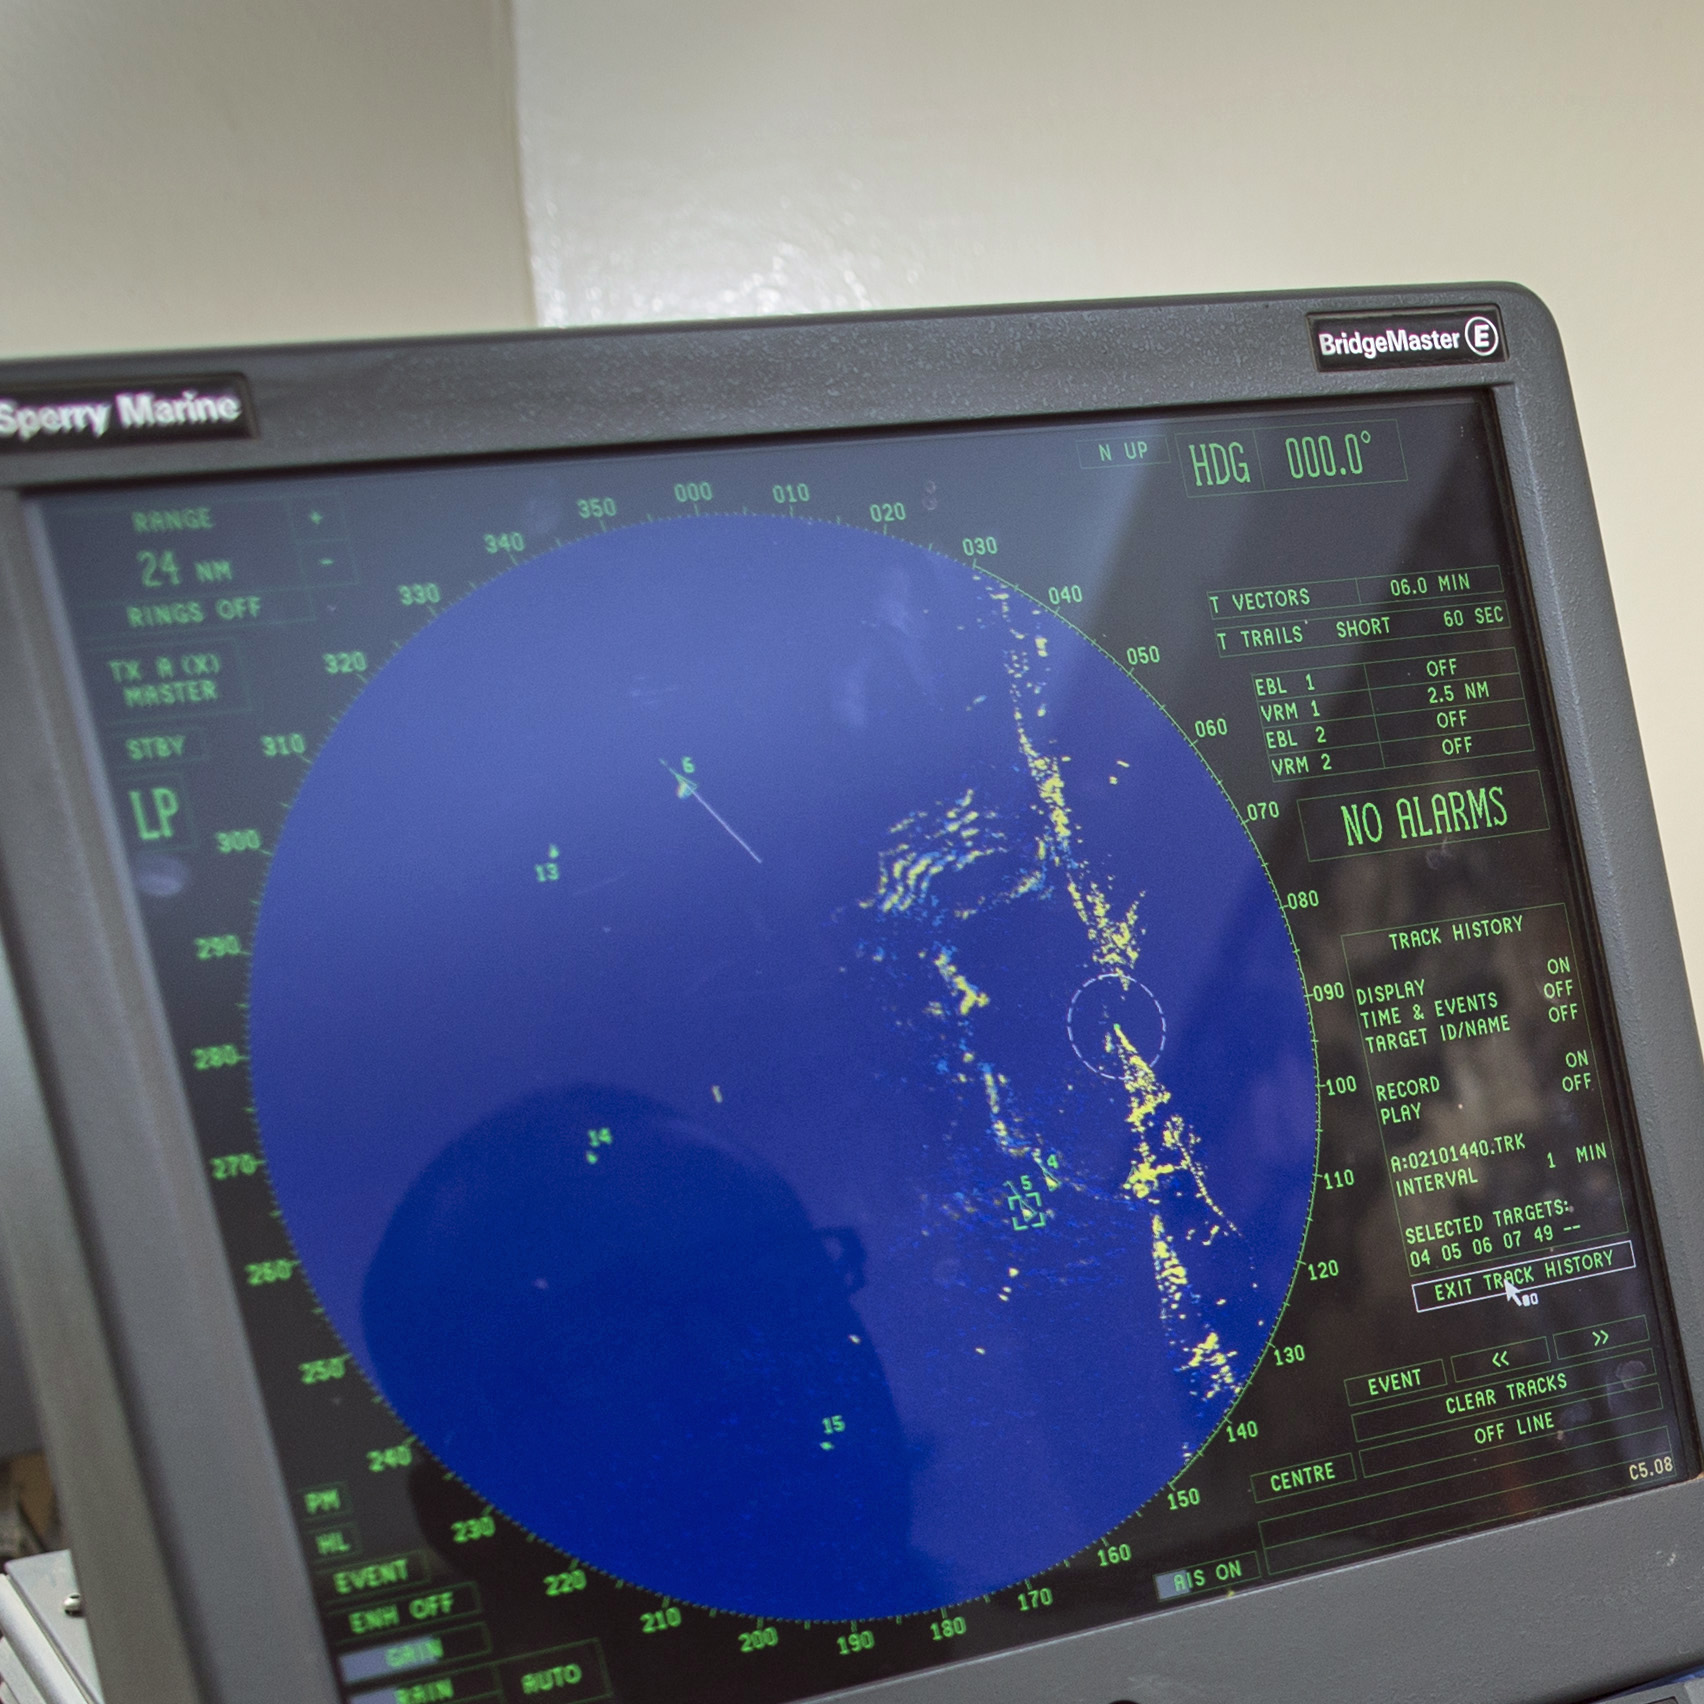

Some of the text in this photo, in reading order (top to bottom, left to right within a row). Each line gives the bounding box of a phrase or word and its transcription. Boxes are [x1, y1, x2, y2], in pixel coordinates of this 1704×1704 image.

[1318, 329, 1460, 360] BridgeMaster
[0, 389, 242, 441] Sperry Marine
[1099, 441, 1148, 461] N UP
[1188, 430, 1372, 486] HDG 000.0°
[674, 481, 712, 502] 000
[772, 483, 809, 502] 010
[132, 508, 213, 532] RANGE
[577, 497, 617, 518] 350
[869, 502, 906, 522] 020
[484, 532, 524, 553] 340
[962, 536, 997, 556] 030
[137, 551, 232, 586] 24 NM
[398, 583, 440, 604] 330
[1048, 585, 1082, 605] 040
[1209, 573, 1471, 614] T VECTORS 06.0 MIN
[128, 597, 261, 627] RINGS OFF
[1217, 605, 1504, 651] T TRAILS SHORT 60 SEC
[323, 651, 366, 674] 320
[1126, 646, 1160, 666] 050
[1255, 658, 1457, 697] EBL 1 OFF
[123, 681, 217, 707] MASTER
[1261, 682, 1489, 722] VRM 1 2.5 NM
[1194, 718, 1228, 738] 060
[1265, 710, 1468, 749] EBL 2 OFF
[126, 735, 185, 760] STBY
[261, 733, 305, 757] 310
[1271, 737, 1473, 777] VRM 2 OFF
[129, 788, 179, 839] LP
[1247, 802, 1280, 821] 070
[1340, 786, 1509, 847] NO ALARMS
[1287, 890, 1320, 910] 080
[1389, 915, 1524, 951] TRACK HISTORY
[1313, 981, 1345, 1002] 090
[1356, 957, 1570, 1006] DISPLAY ON
[1360, 979, 1574, 1030] TIME & EVENTS OFF
[1365, 1003, 1579, 1054] TARGET ID/NAME OFF
[1325, 1076, 1357, 1096] 100
[1375, 1050, 1589, 1103] RECORD ON
[1381, 1072, 1592, 1126] PLAY OFF
[1390, 1133, 1526, 1173] A:02101440.TRK
[1323, 1170, 1355, 1190] 110
[1396, 1143, 1607, 1197] INTERVAL 1 MIN
[1405, 1198, 1570, 1244] SELECTED TARGETS:
[1410, 1224, 1555, 1268] 04 05 06 07 49
[1307, 1260, 1339, 1281] 120
[1435, 1249, 1614, 1301] EXIT TRACK HISTORY
[1273, 1344, 1305, 1366] 130
[1367, 1369, 1423, 1396] EVENT
[1445, 1373, 1568, 1414] CLEAR TRACKS
[1226, 1421, 1258, 1442] 140
[1474, 1412, 1555, 1444] OFF LINE
[1271, 1462, 1336, 1492] CENTRE
[1629, 1456, 1674, 1481] C5.08
[1168, 1487, 1201, 1510] 150
[451, 1515, 497, 1543] 230
[1097, 1543, 1131, 1567] 160
[333, 1558, 408, 1594] EVENT
[543, 1570, 587, 1596] 220
[1173, 1560, 1242, 1592] AIS ON
[1017, 1587, 1053, 1611] 170
[639, 1607, 682, 1634] 210
[930, 1616, 966, 1640] 180
[738, 1627, 778, 1653] 200
[521, 1663, 582, 1694] AUTO
